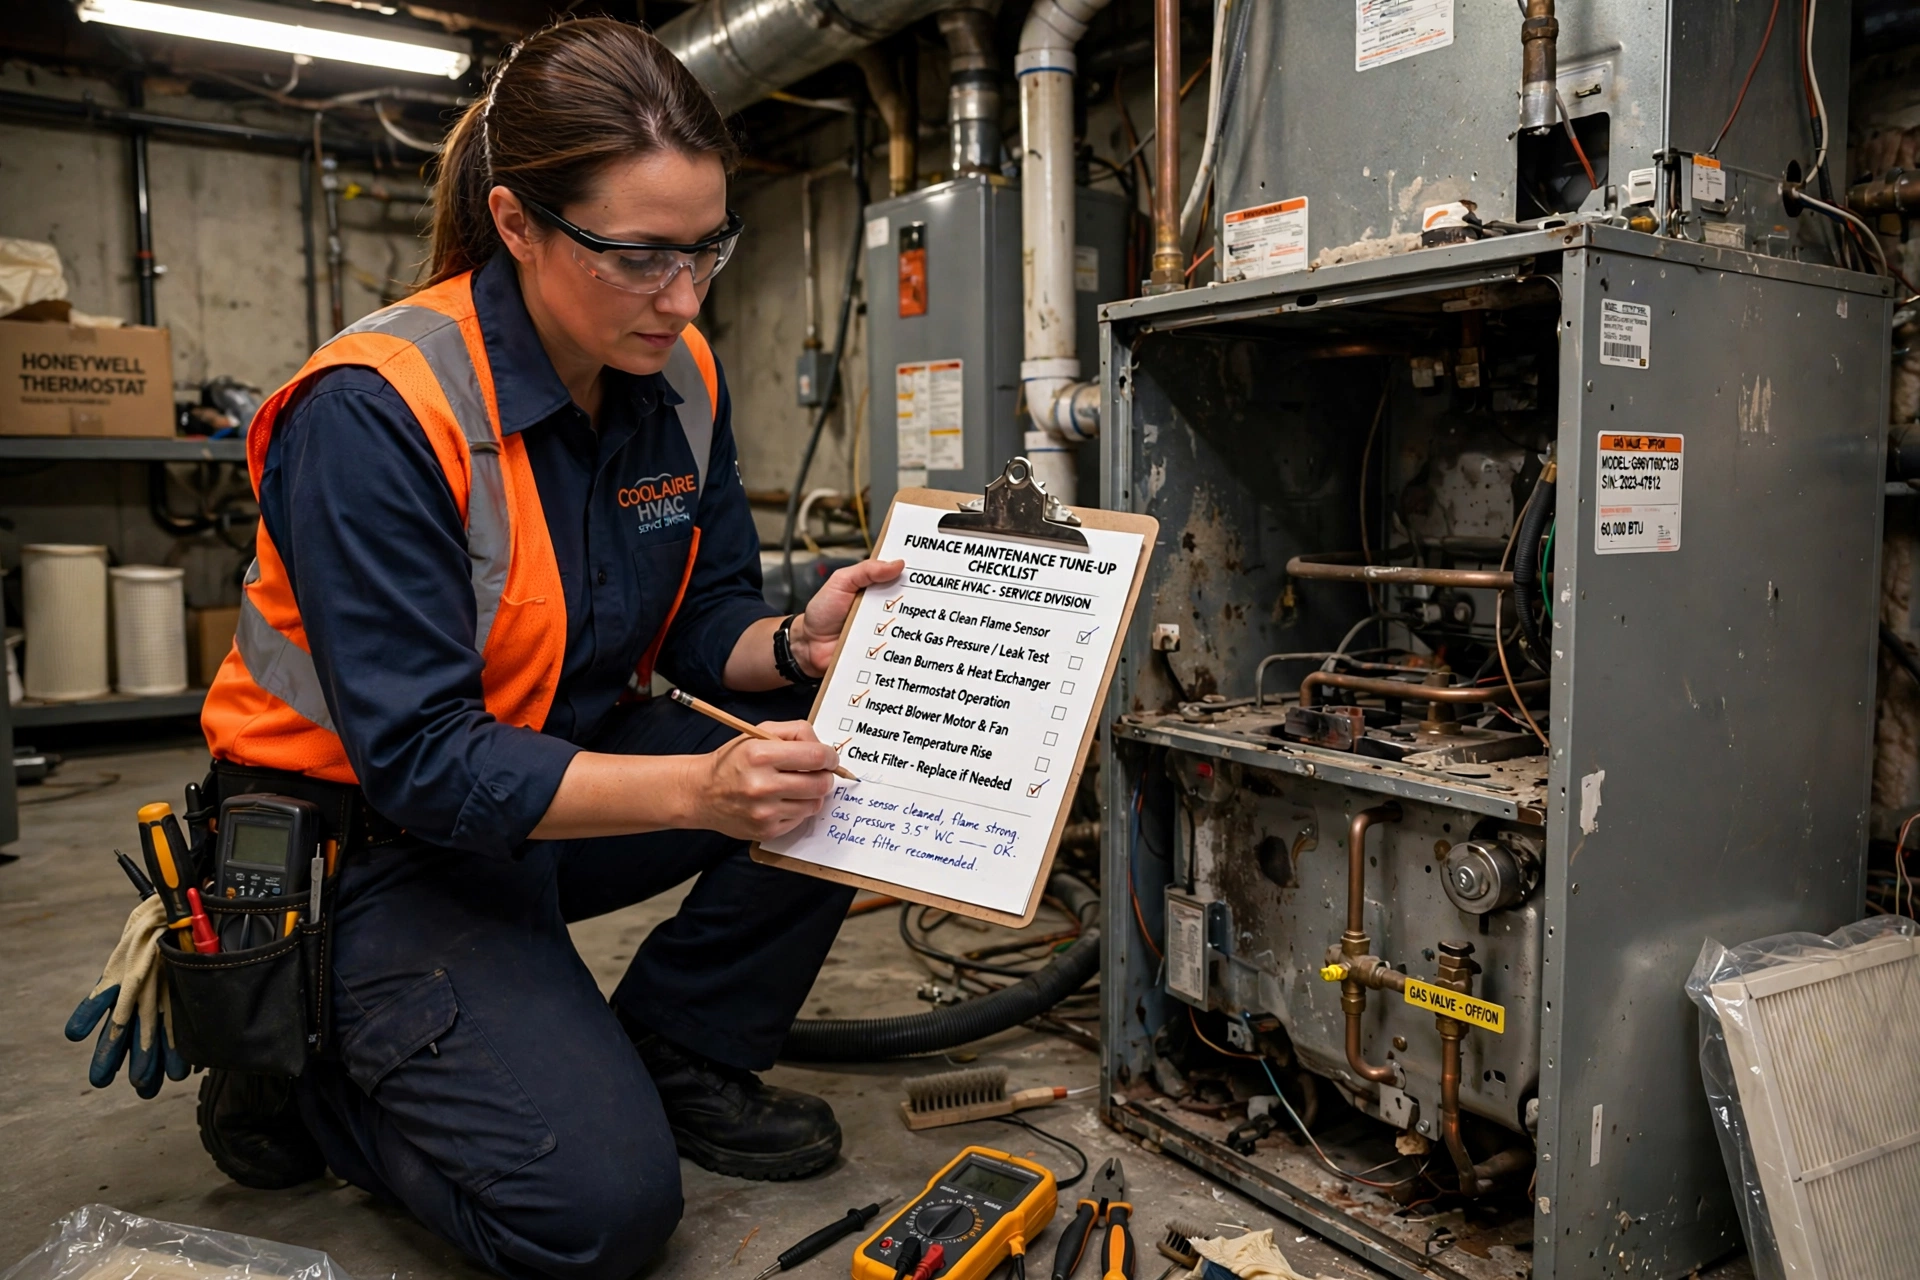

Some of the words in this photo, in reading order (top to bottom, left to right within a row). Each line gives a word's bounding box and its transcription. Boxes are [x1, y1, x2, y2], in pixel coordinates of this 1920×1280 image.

[22, 353, 146, 374] HONEYWELL
[20, 374, 147, 395] THERMOSTAT
[618, 474, 697, 508] COOLAIRE
[637, 495, 686, 522] HVAC
[1600, 522, 1627, 539] 60,000
[1628, 521, 1644, 535] BTU
[904, 534, 963, 554] FURNACE
[963, 542, 1057, 567] MAINTENANCE
[1060, 556, 1117, 575] TUNE-UP
[968, 560, 1039, 581] CHECKLIST
[909, 572, 962, 590] COOLAIRE
[961, 580, 991, 595] HVAC
[998, 586, 1043, 602] SERVICE
[1043, 592, 1092, 610] DIVISION
[898, 602, 937, 619] Inspect
[937, 608, 946, 621] &
[949, 610, 978, 626] Clean
[979, 615, 1012, 632] Flame
[1013, 621, 1051, 638] Sensor
[891, 626, 923, 642] Check
[924, 632, 944, 646] Gas
[945, 635, 990, 654] Pressure
[990, 643, 999, 656] /
[999, 644, 1025, 660] Leak
[1028, 648, 1050, 664] Test
[883, 650, 912, 666] Clean
[914, 655, 954, 673] Burners
[956, 662, 965, 675] &
[967, 665, 993, 680] Heat
[994, 669, 1051, 692] Exchanger
[875, 673, 896, 688] Test
[897, 677, 957, 700] Thermostat
[957, 689, 1011, 710] Operation
[865, 697, 904, 716] Inspect
[904, 705, 942, 723] Blower
[942, 712, 977, 729] Motor
[977, 719, 987, 732] &
[988, 721, 1009, 736] Fan
[855, 721, 900, 742] Measure
[902, 730, 968, 755] Temperature
[970, 744, 993, 760] Rise
[848, 746, 880, 763] Check
[881, 753, 909, 769] Filter
[916, 760, 957, 780] Replace
[958, 768, 970, 782] if
[969, 771, 1013, 791] Needed
[831, 805, 850, 821] Gas
[852, 815, 896, 831] pressure
[935, 829, 954, 844] WC
[833, 786, 864, 805] Flame
[867, 799, 899, 811] sensor
[952, 811, 980, 831] flame
[985, 822, 1020, 845] strong.
[827, 824, 866, 845] Replace
[872, 834, 901, 851] filter
[1410, 986, 1427, 1002] GAS
[1429, 992, 1456, 1012] VALVE
[1465, 1003, 1498, 1025] OFF/ON
